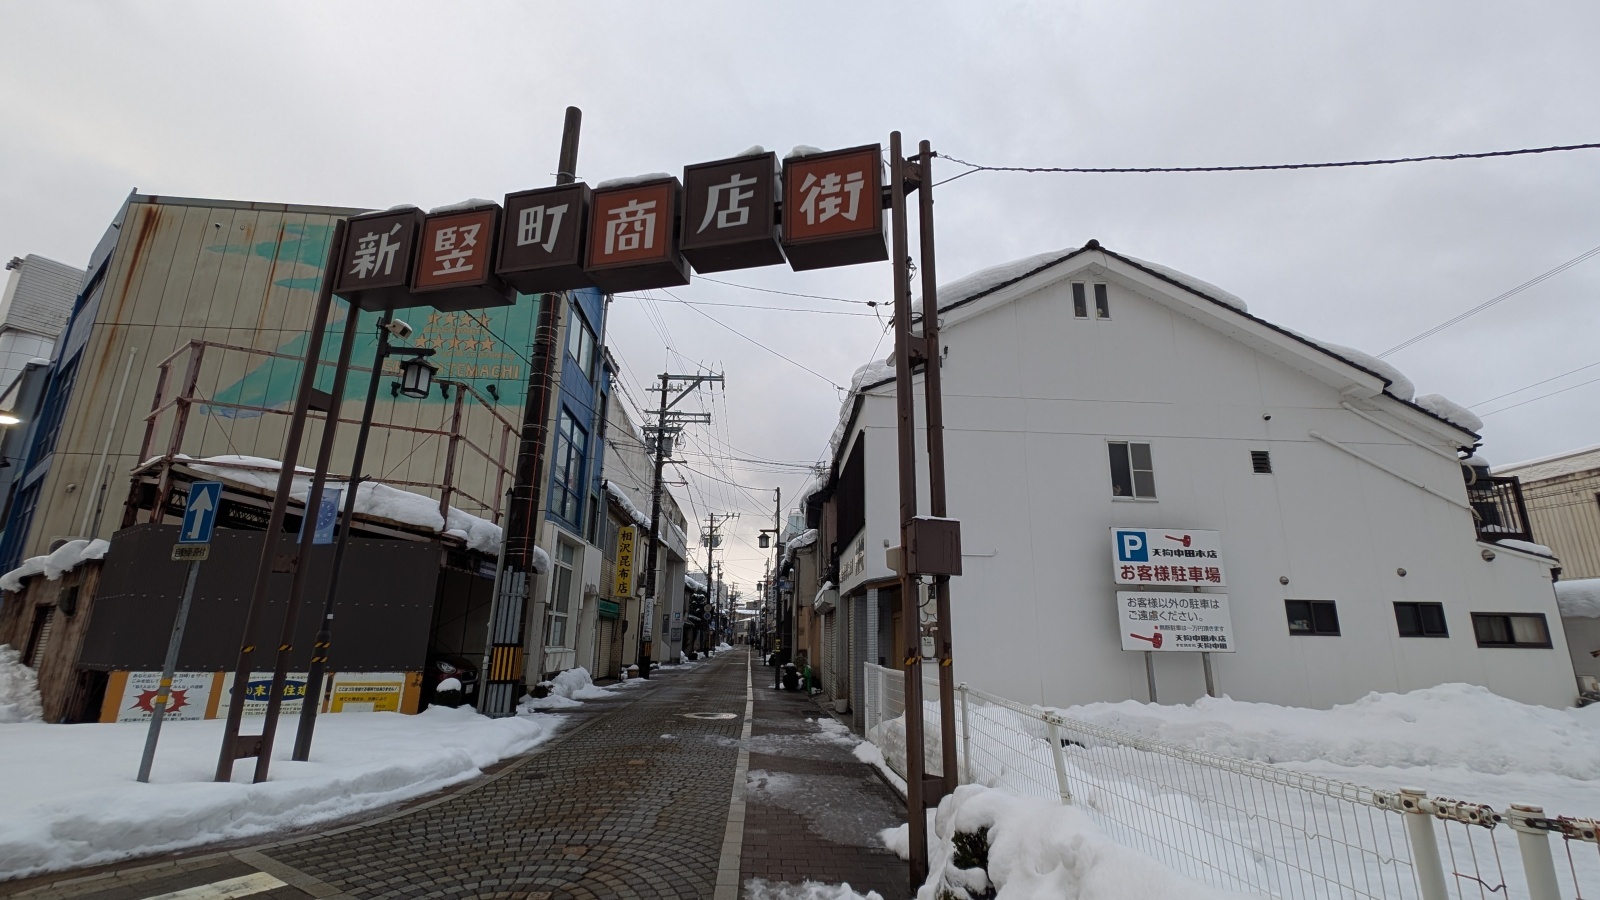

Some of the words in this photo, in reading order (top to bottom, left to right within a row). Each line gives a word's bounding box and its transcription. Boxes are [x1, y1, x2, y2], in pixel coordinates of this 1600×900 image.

[348, 169, 865, 279] 新竪町商店街
[1123, 534, 1143, 559] P
[1152, 548, 1218, 559] 天狗中田本店
[616, 530, 633, 594] 相沢昆布店
[1120, 565, 1221, 584] お客様駐車場
[1127, 597, 1220, 610] お客様以外の駐車は
[1128, 610, 1204, 622] ご遠慮ください。
[1175, 634, 1227, 643] 天狗中田本店
